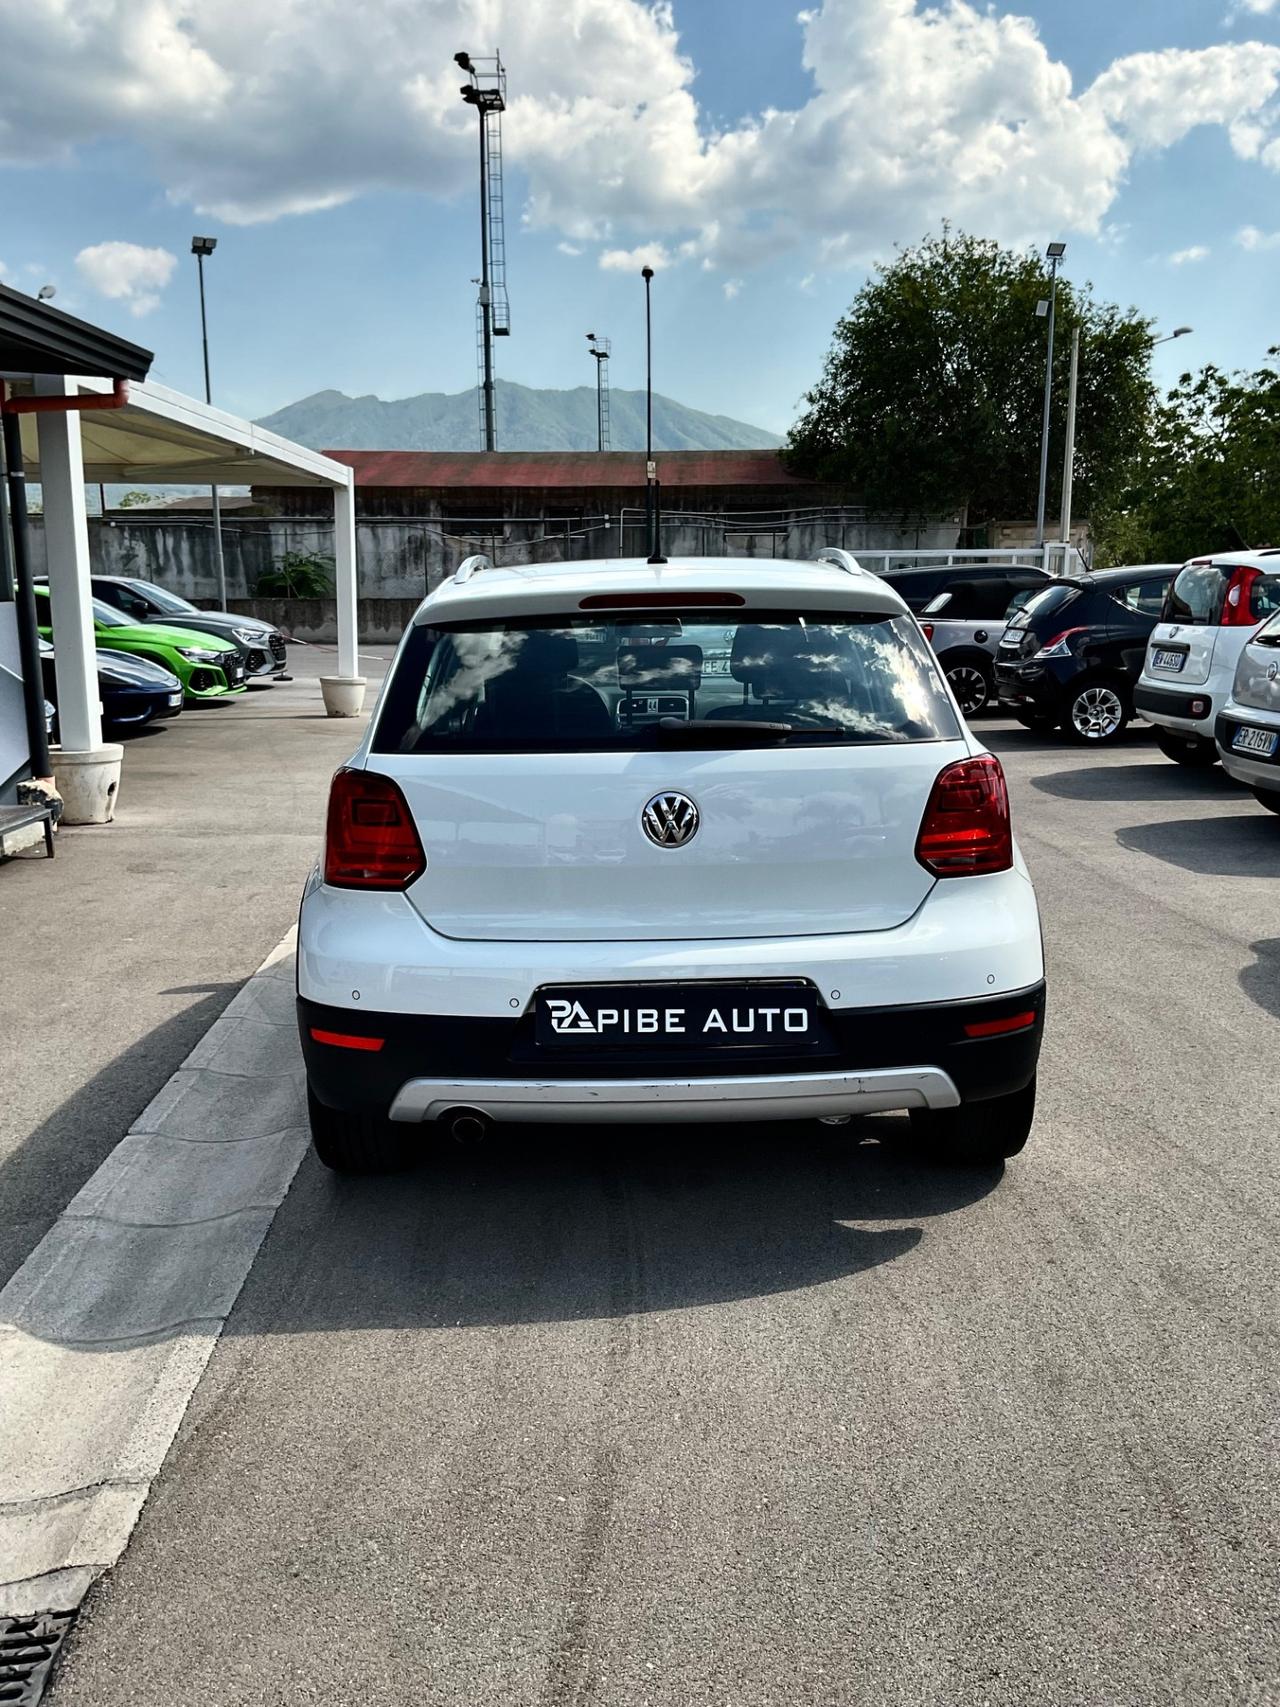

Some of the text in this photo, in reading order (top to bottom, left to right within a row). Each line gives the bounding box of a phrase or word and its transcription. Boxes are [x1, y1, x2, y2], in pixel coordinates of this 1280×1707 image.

[703, 661, 718, 673] FE
[1237, 728, 1249, 745] ER
[598, 1008, 686, 1033] PIBE
[702, 1008, 809, 1032] AUTO
